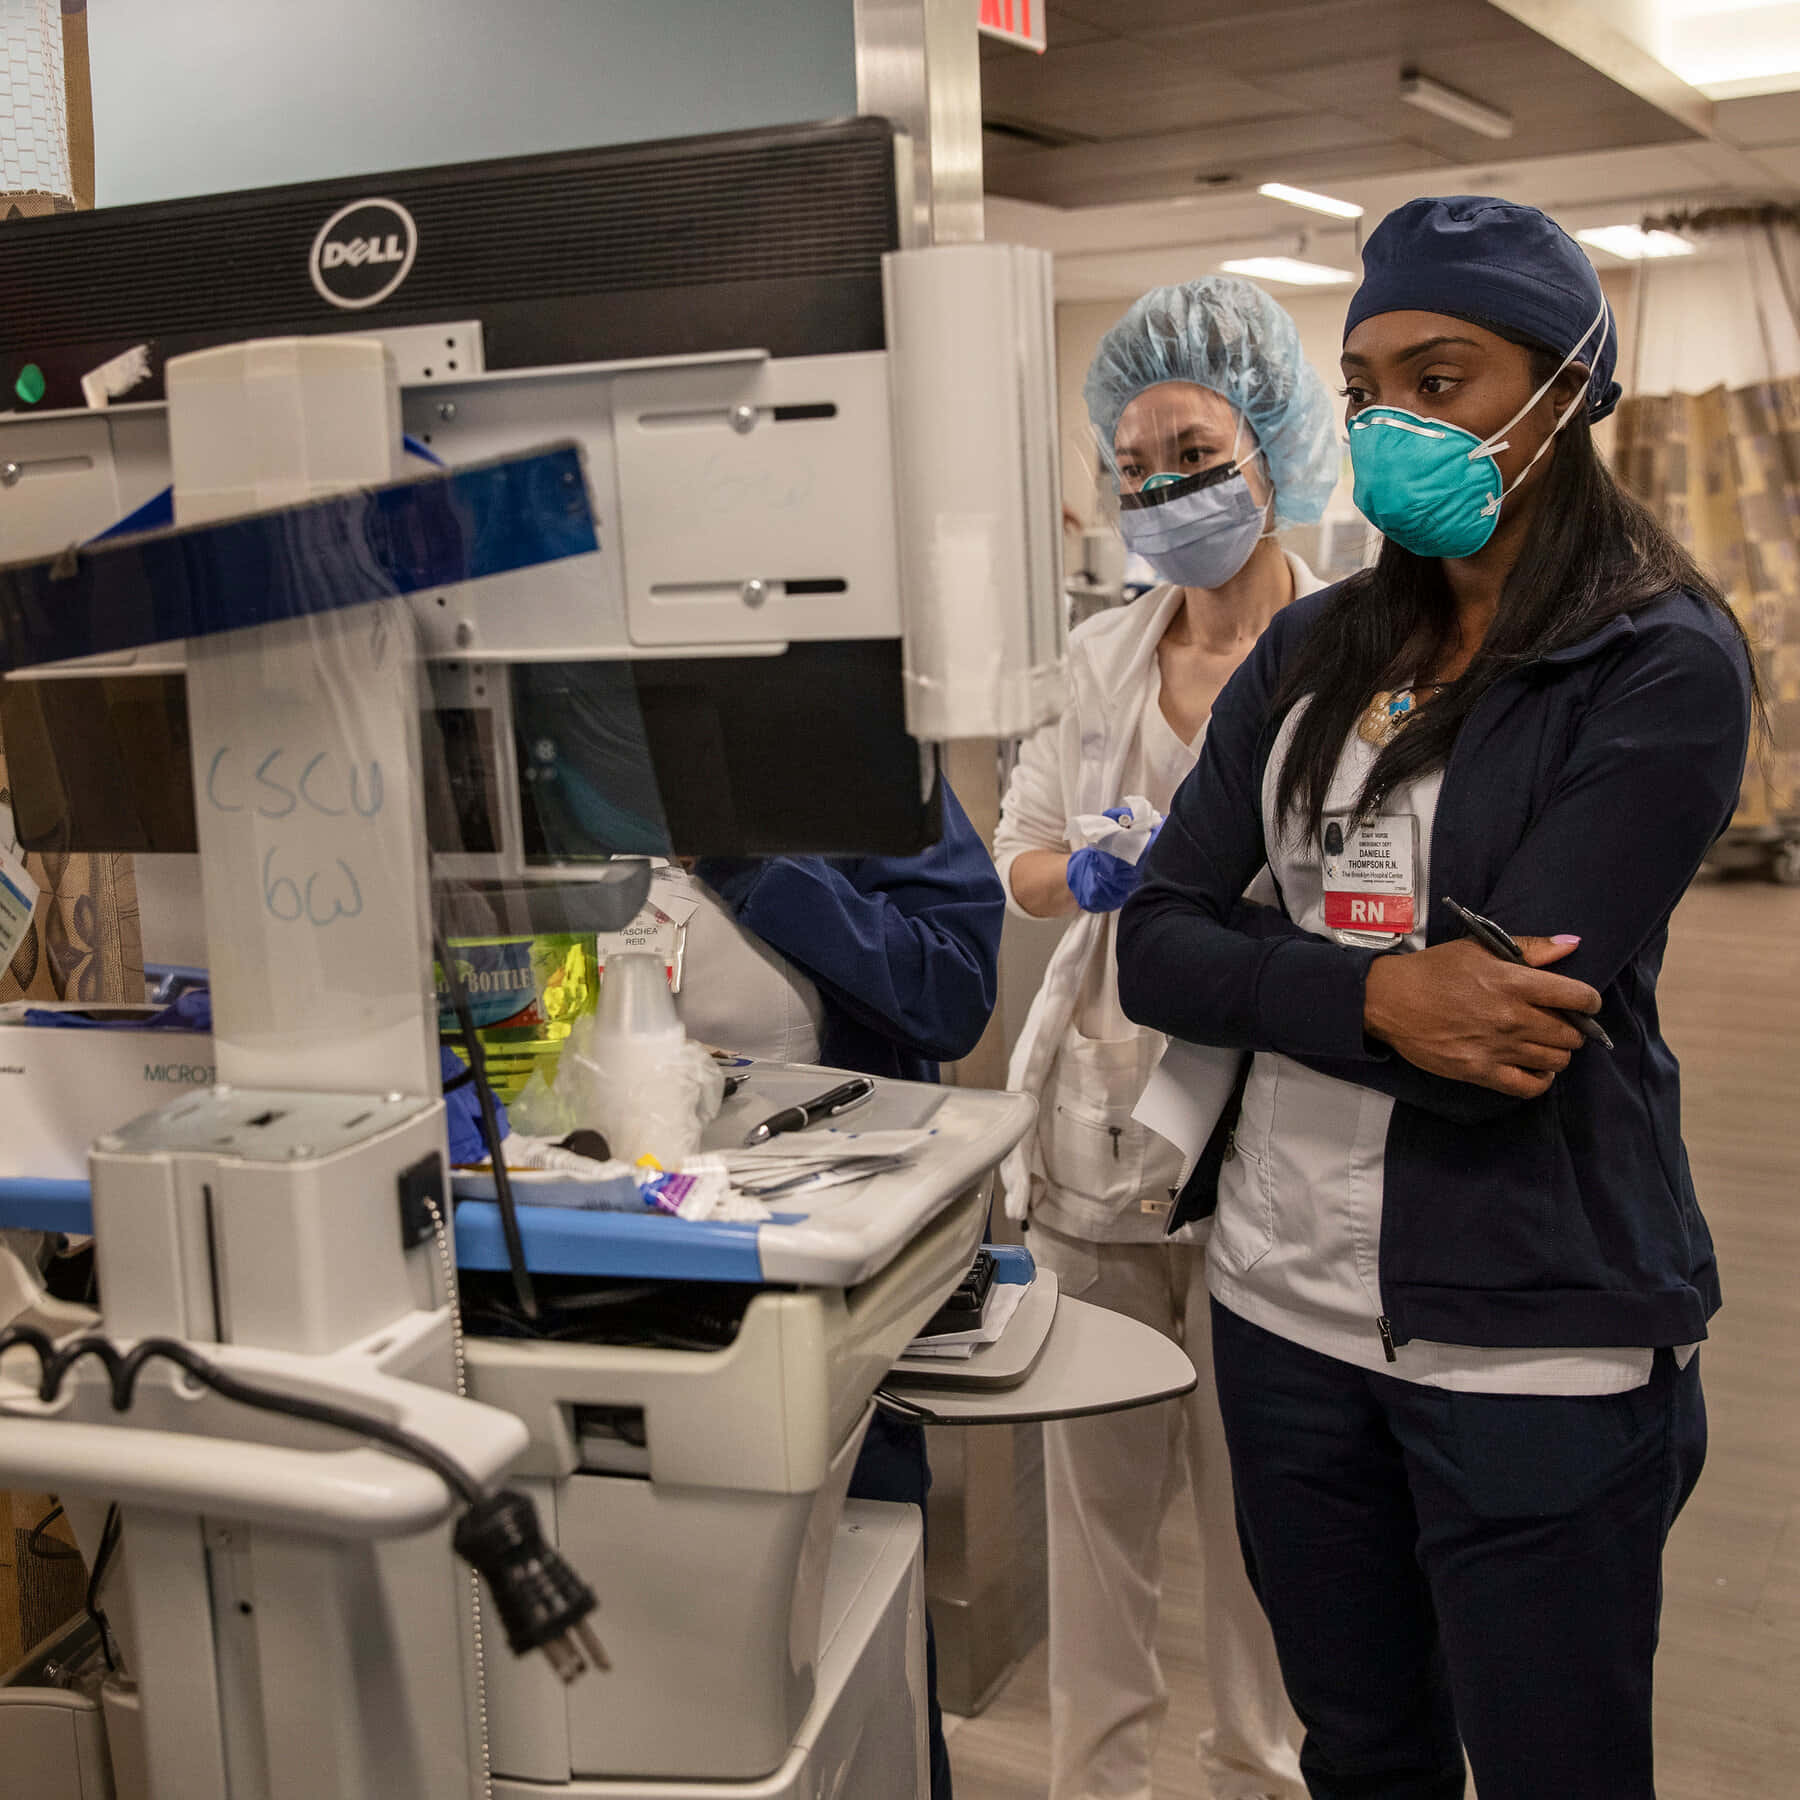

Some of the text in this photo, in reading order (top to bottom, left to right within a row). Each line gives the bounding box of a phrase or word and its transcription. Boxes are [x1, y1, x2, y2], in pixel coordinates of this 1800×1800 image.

[322, 234, 404, 269] DELL
[1359, 849, 1391, 858] DANIELLE
[1348, 860, 1384, 869] THOMPSON
[1350, 899, 1385, 923] RN
[625, 937, 646, 946] REID
